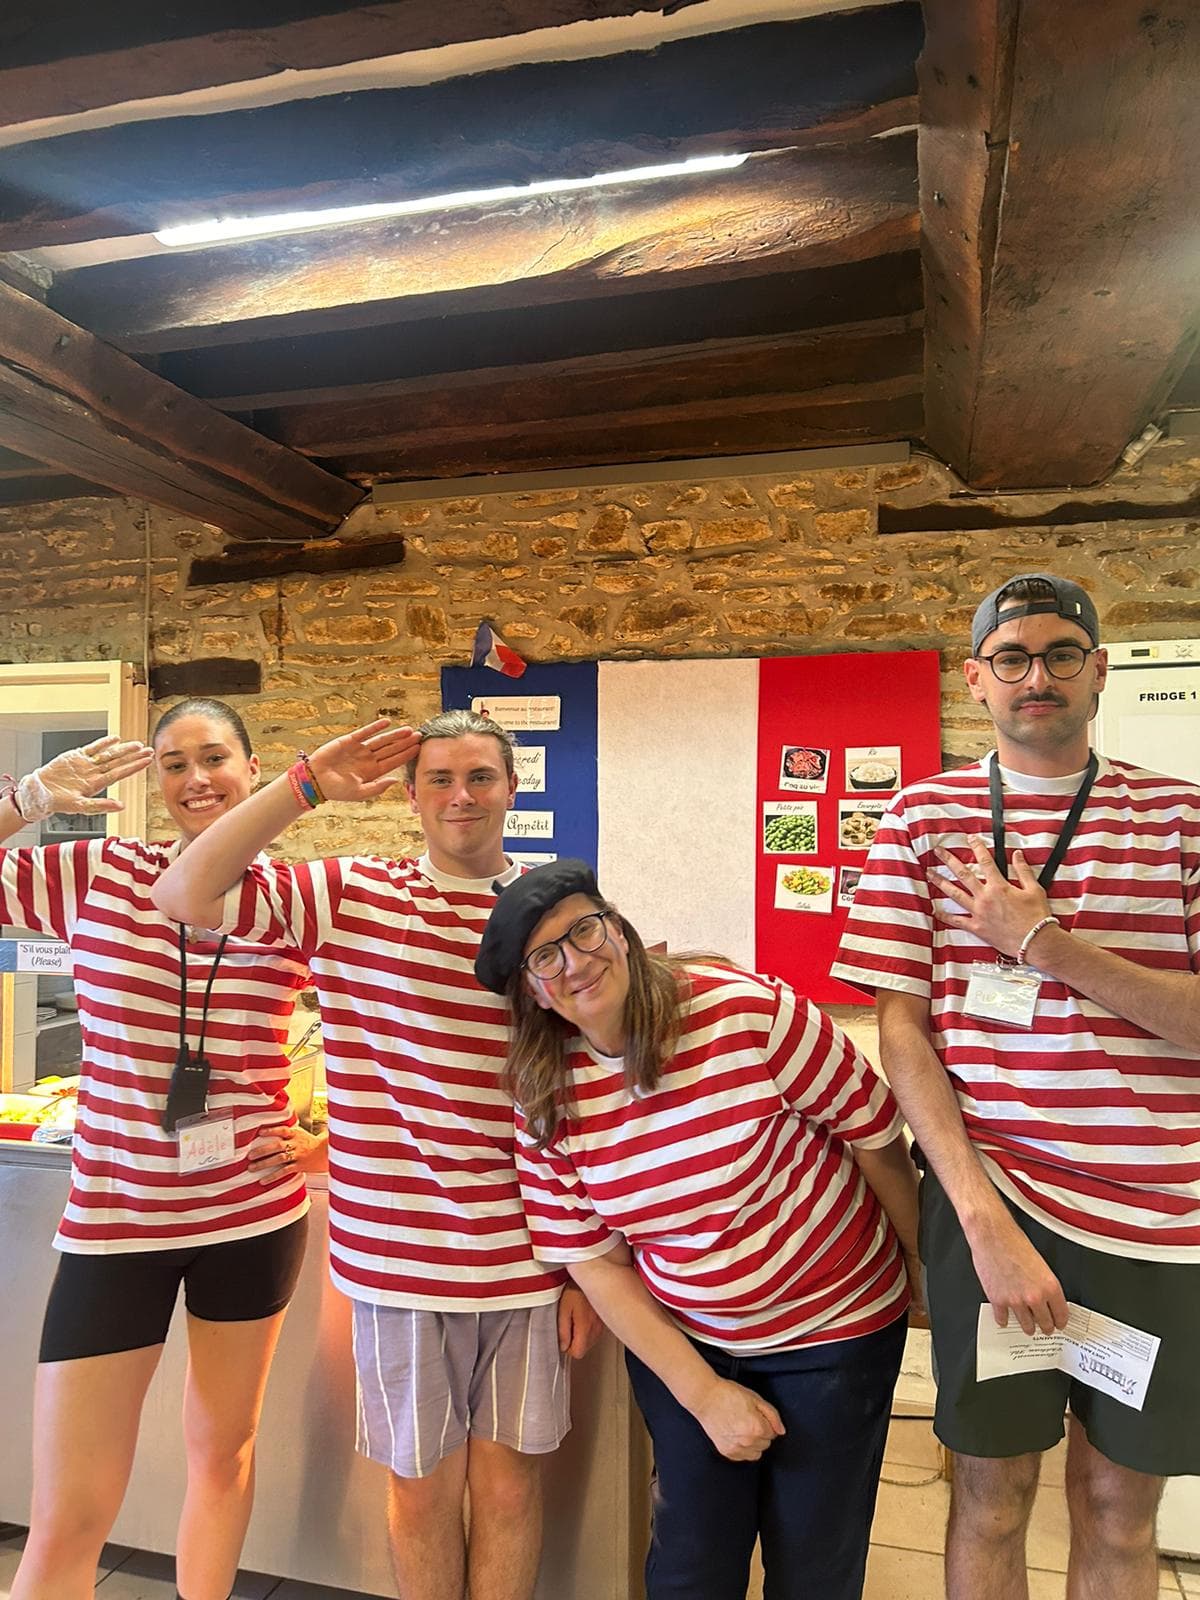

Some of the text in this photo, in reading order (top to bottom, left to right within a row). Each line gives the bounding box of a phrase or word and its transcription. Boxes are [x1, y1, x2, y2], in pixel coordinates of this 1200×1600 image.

[1139, 690, 1197, 702] FRIDGE 1
[35, 946, 53, 954] vous
